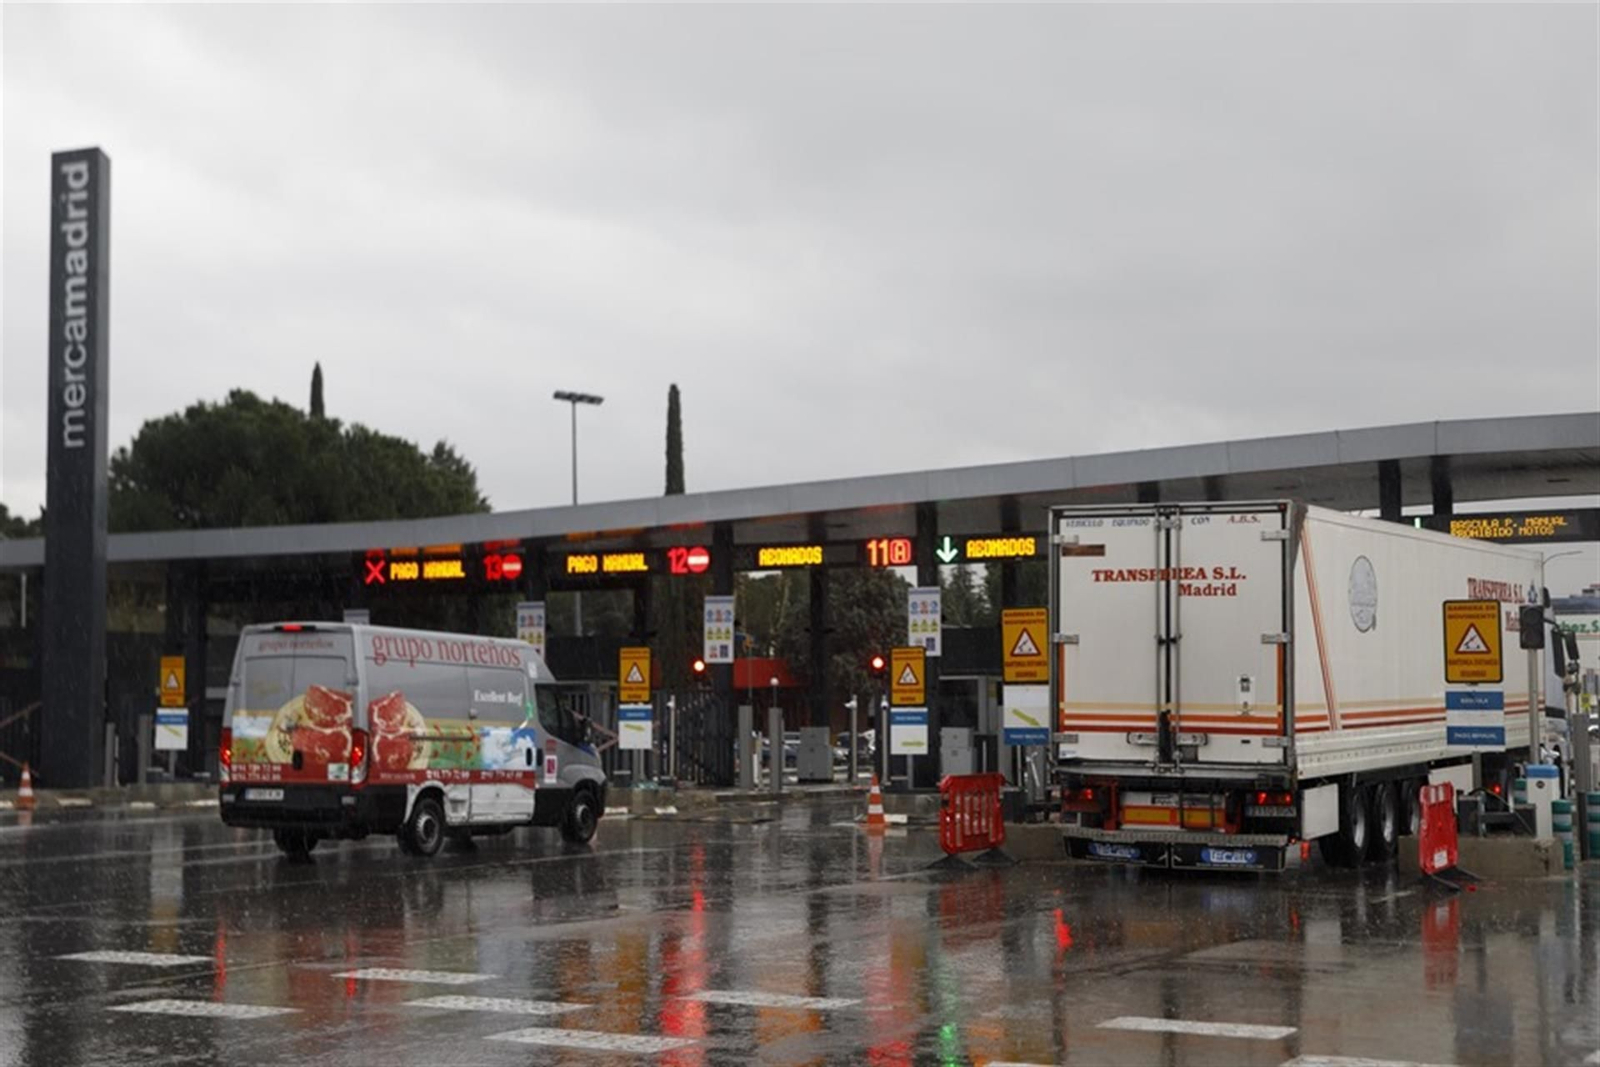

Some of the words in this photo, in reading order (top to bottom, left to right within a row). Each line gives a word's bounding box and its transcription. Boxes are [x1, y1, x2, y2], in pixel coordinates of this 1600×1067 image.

[60, 161, 89, 448] mercamadrid
[1191, 516, 1211, 526] CON
[1519, 525, 1554, 536] MOTOS
[1525, 516, 1568, 527] MANUAL
[758, 546, 823, 567] ABONADOS
[966, 537, 1036, 558] ABONADOS
[390, 561, 419, 580] PAGO
[423, 560, 466, 579] MANUAL
[483, 554, 501, 580] 13
[567, 555, 598, 573] PAGO
[602, 553, 649, 572] MANUAL
[667, 547, 689, 574] 12
[1212, 567, 1247, 581] S.L.
[1177, 584, 1237, 597] Madrid
[372, 634, 433, 667] grupo
[437, 638, 522, 667] norteños
